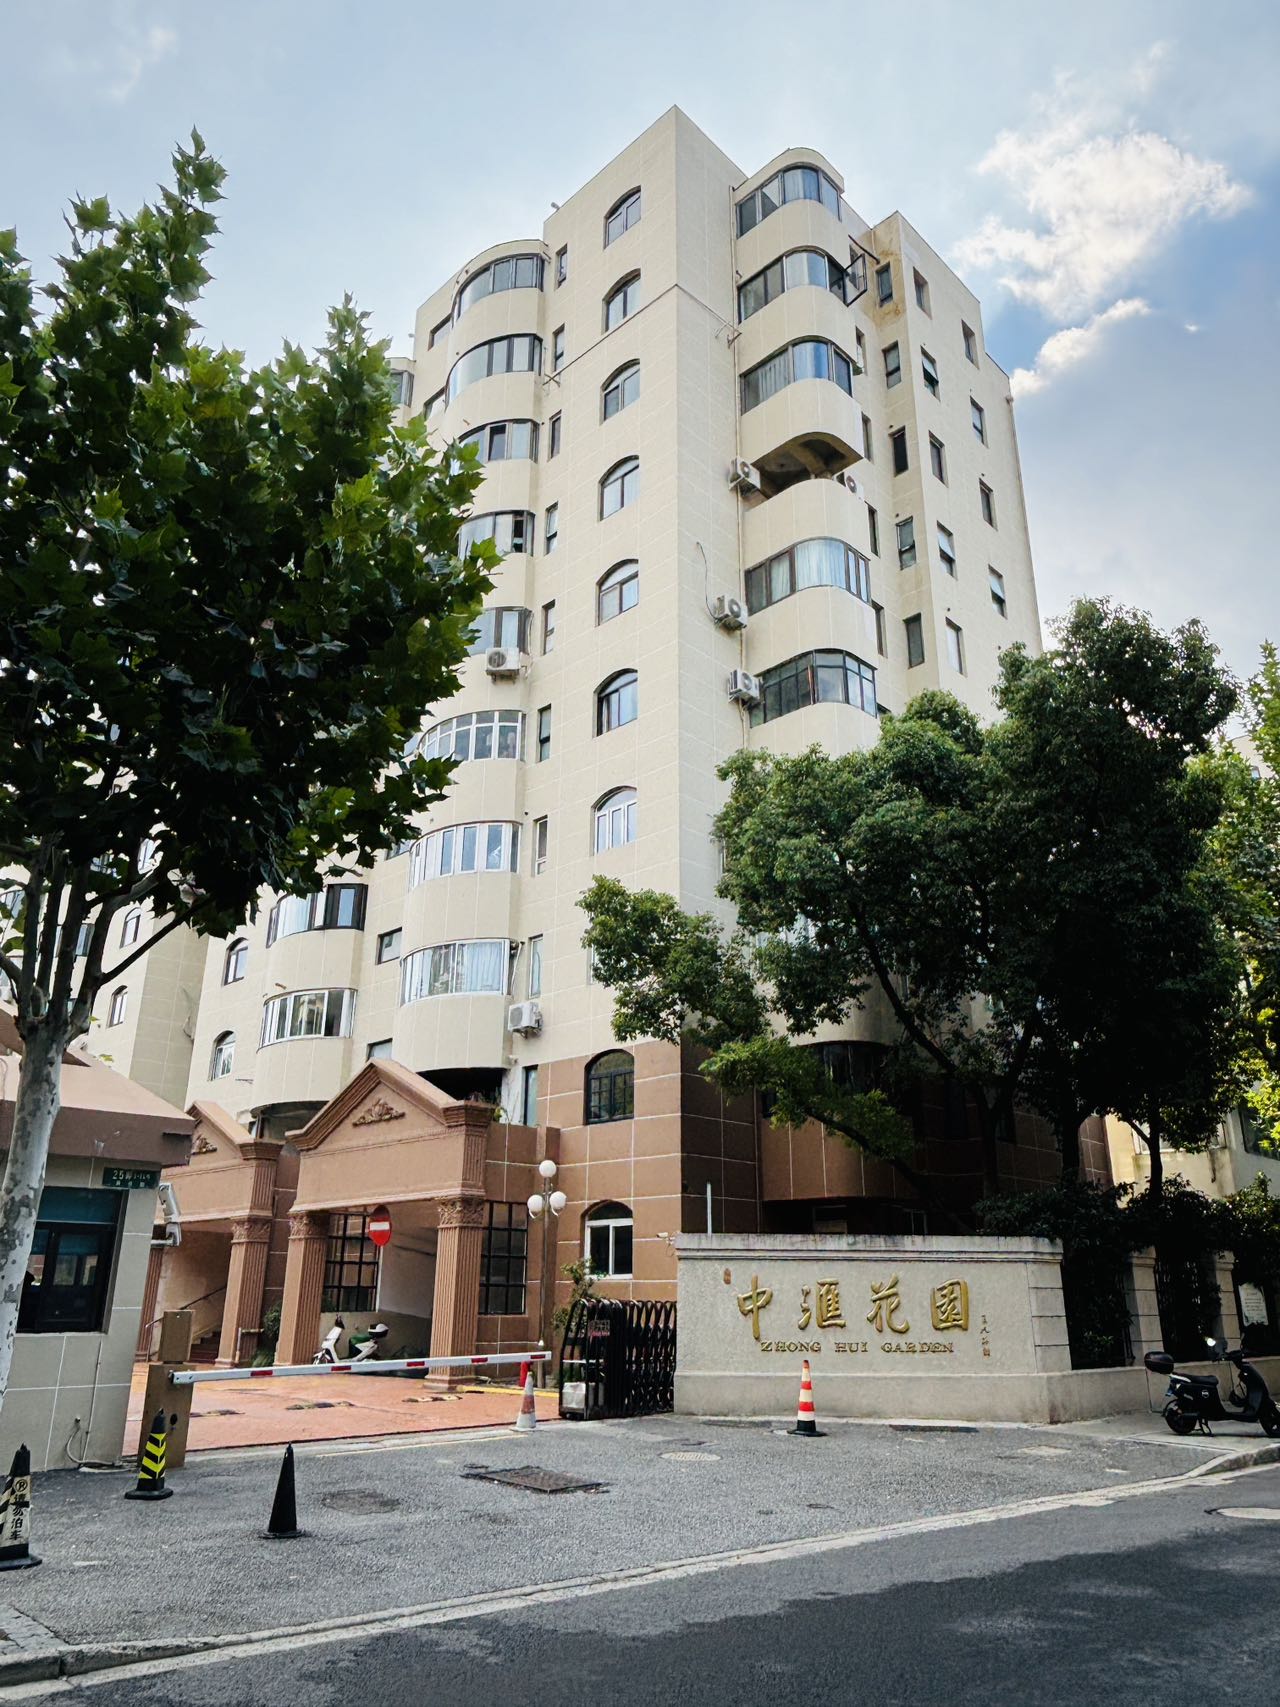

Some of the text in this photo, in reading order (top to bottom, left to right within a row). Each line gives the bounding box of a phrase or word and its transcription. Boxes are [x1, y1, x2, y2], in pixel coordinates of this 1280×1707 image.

[761, 1341, 954, 1353] ZHONG HUI GARDEN
